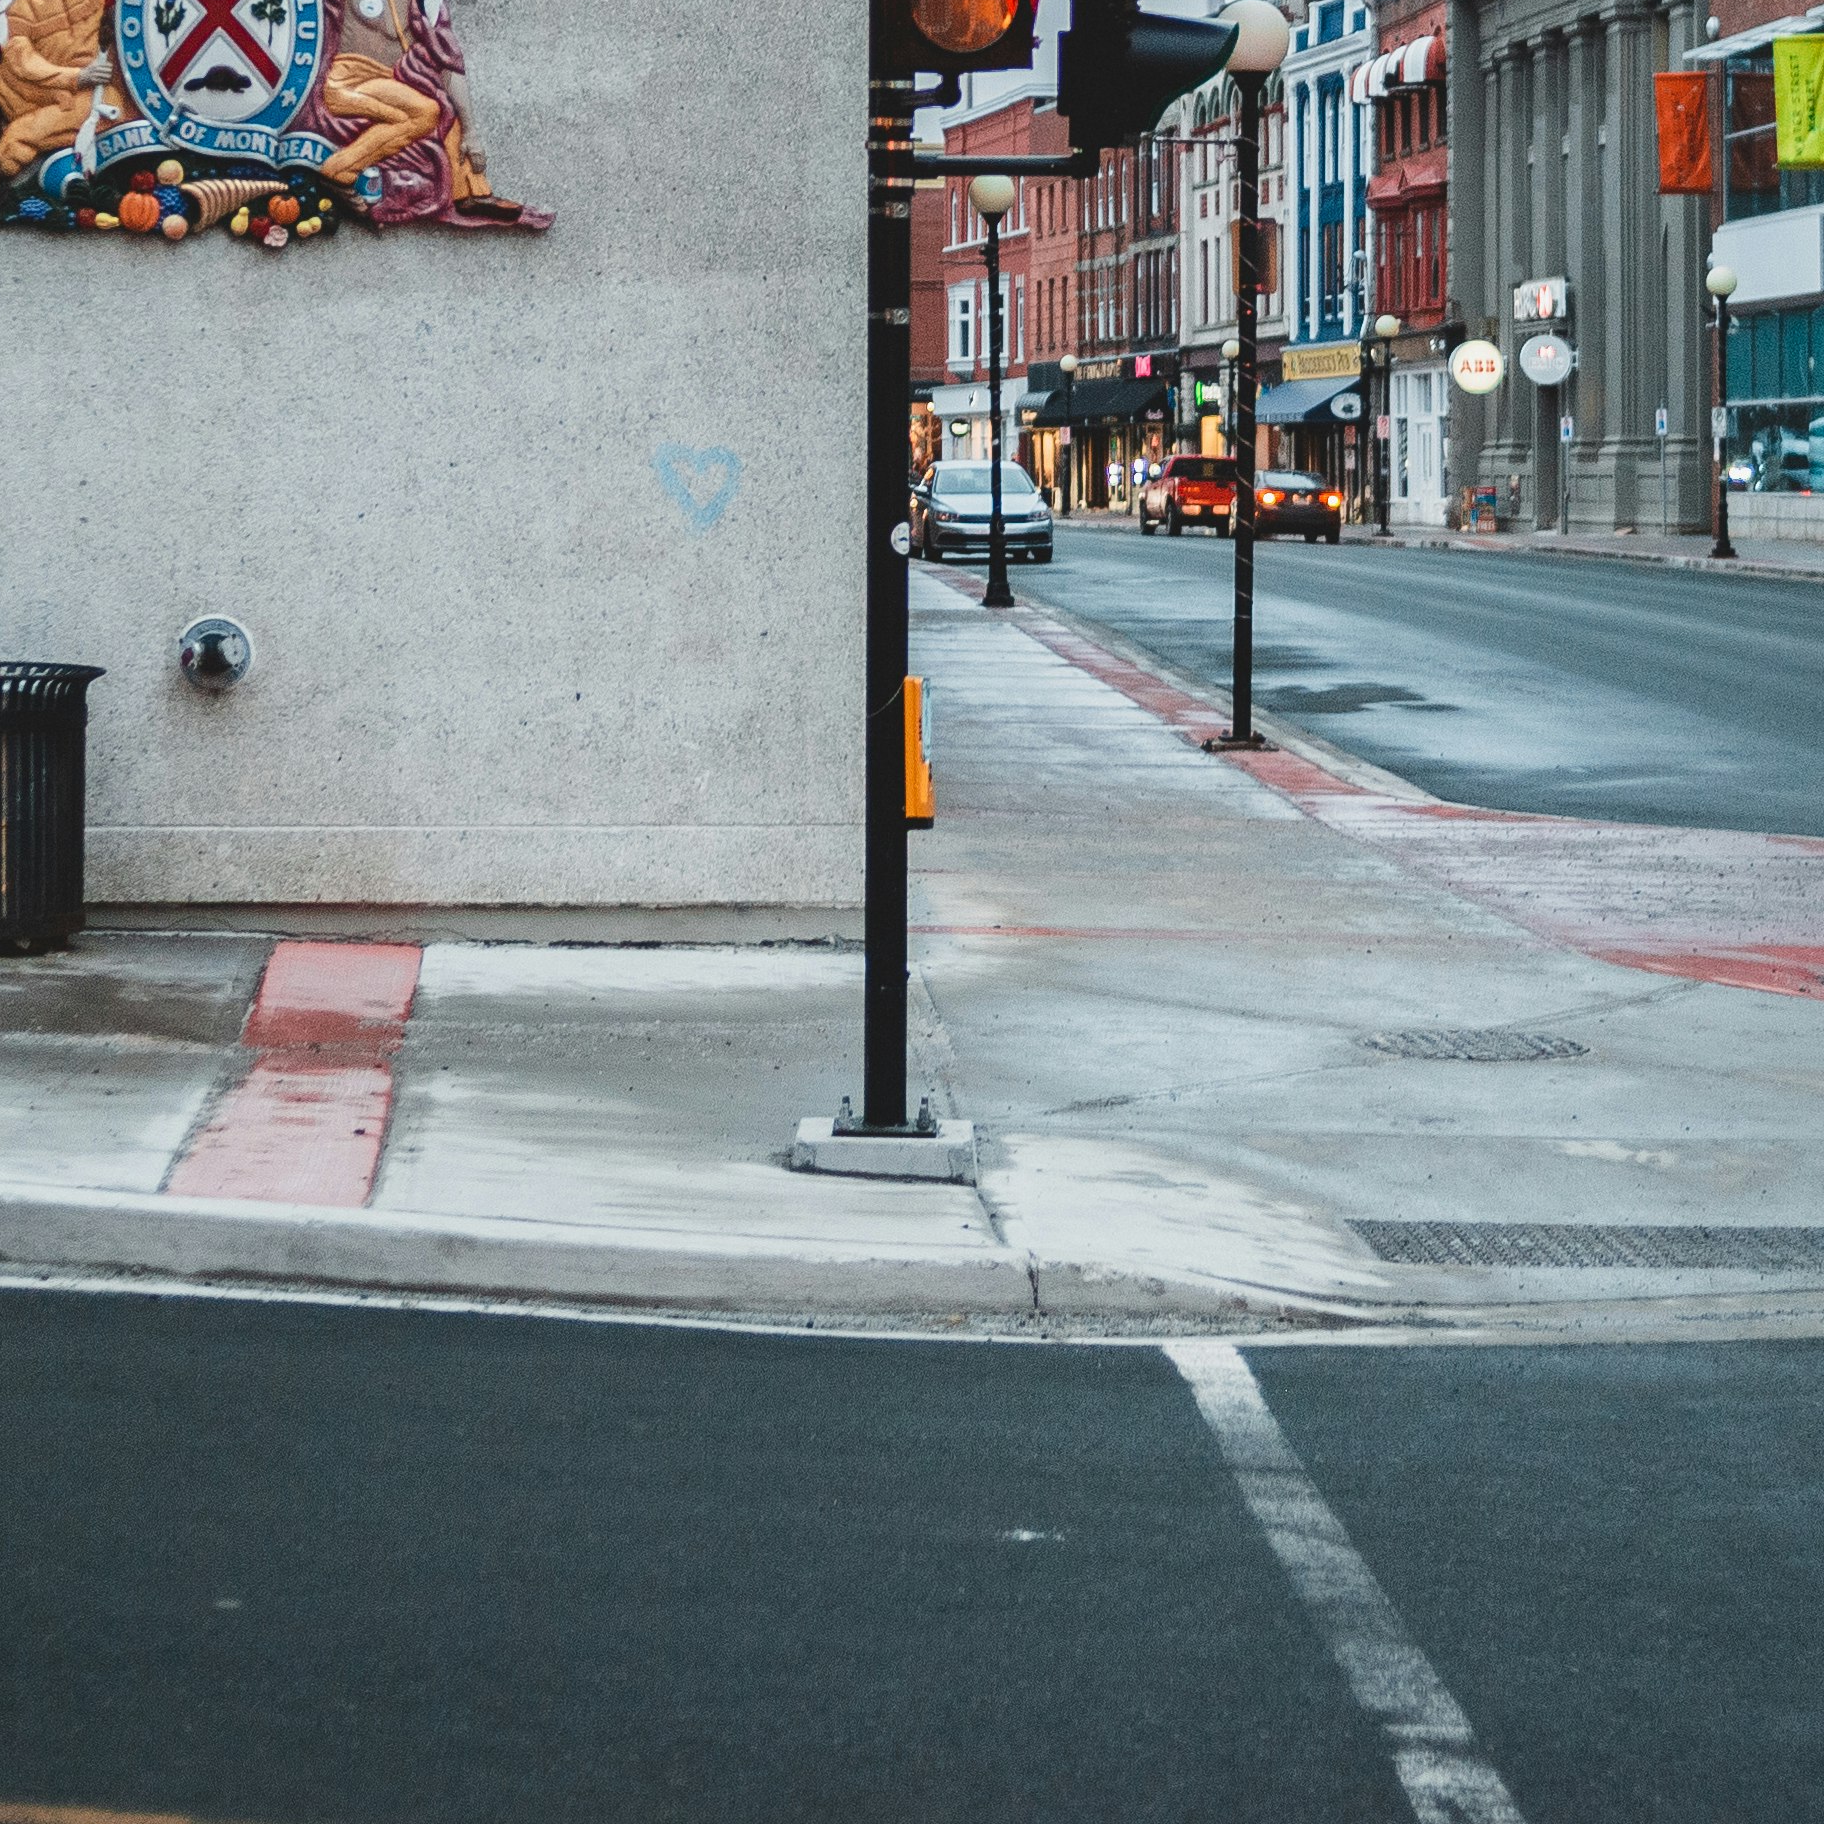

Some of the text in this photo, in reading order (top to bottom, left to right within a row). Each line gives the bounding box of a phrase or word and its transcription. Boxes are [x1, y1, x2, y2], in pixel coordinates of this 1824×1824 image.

[97, 121, 326, 164] BANK OF MONTREAL
[1460, 358, 1496, 374] ABB
